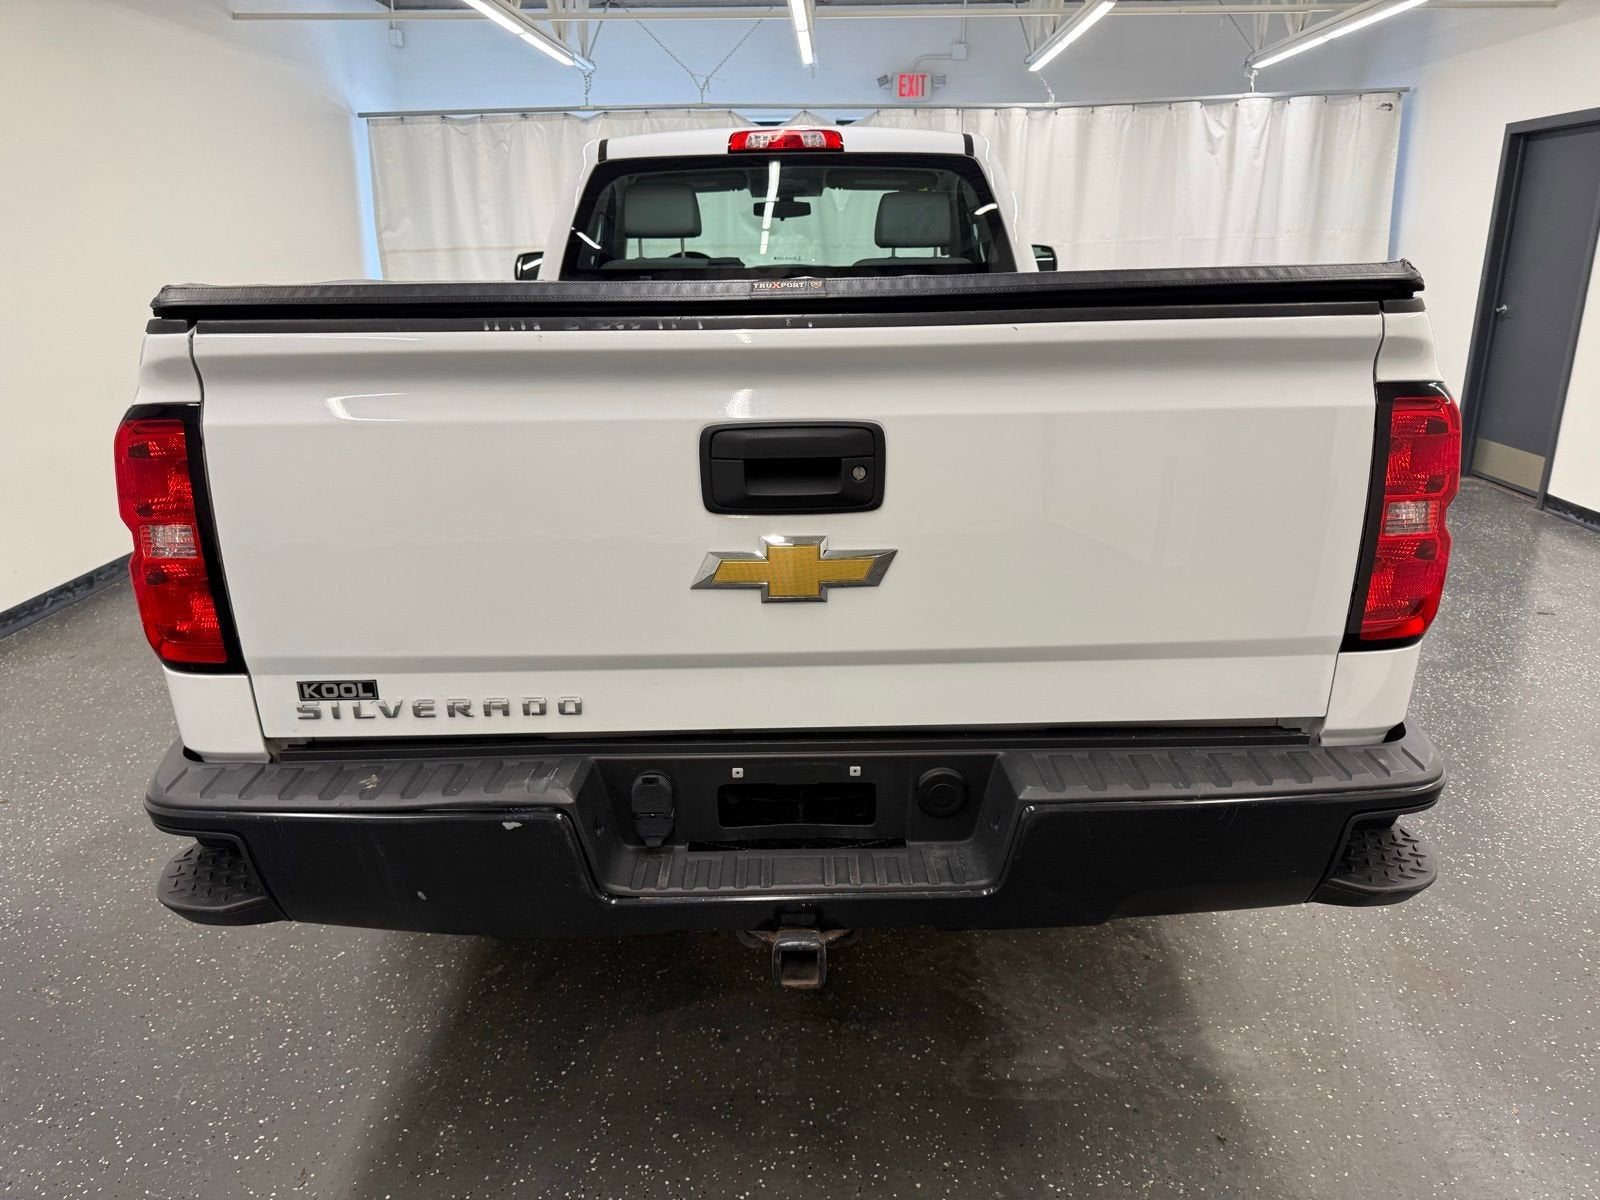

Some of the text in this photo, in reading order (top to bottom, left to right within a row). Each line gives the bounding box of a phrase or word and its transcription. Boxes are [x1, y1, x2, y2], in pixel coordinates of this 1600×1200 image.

[898, 74, 927, 97] EXIT
[753, 281, 805, 289] TRUXPORT
[302, 683, 374, 699] KOOL
[297, 696, 583, 720] SILVERADO
